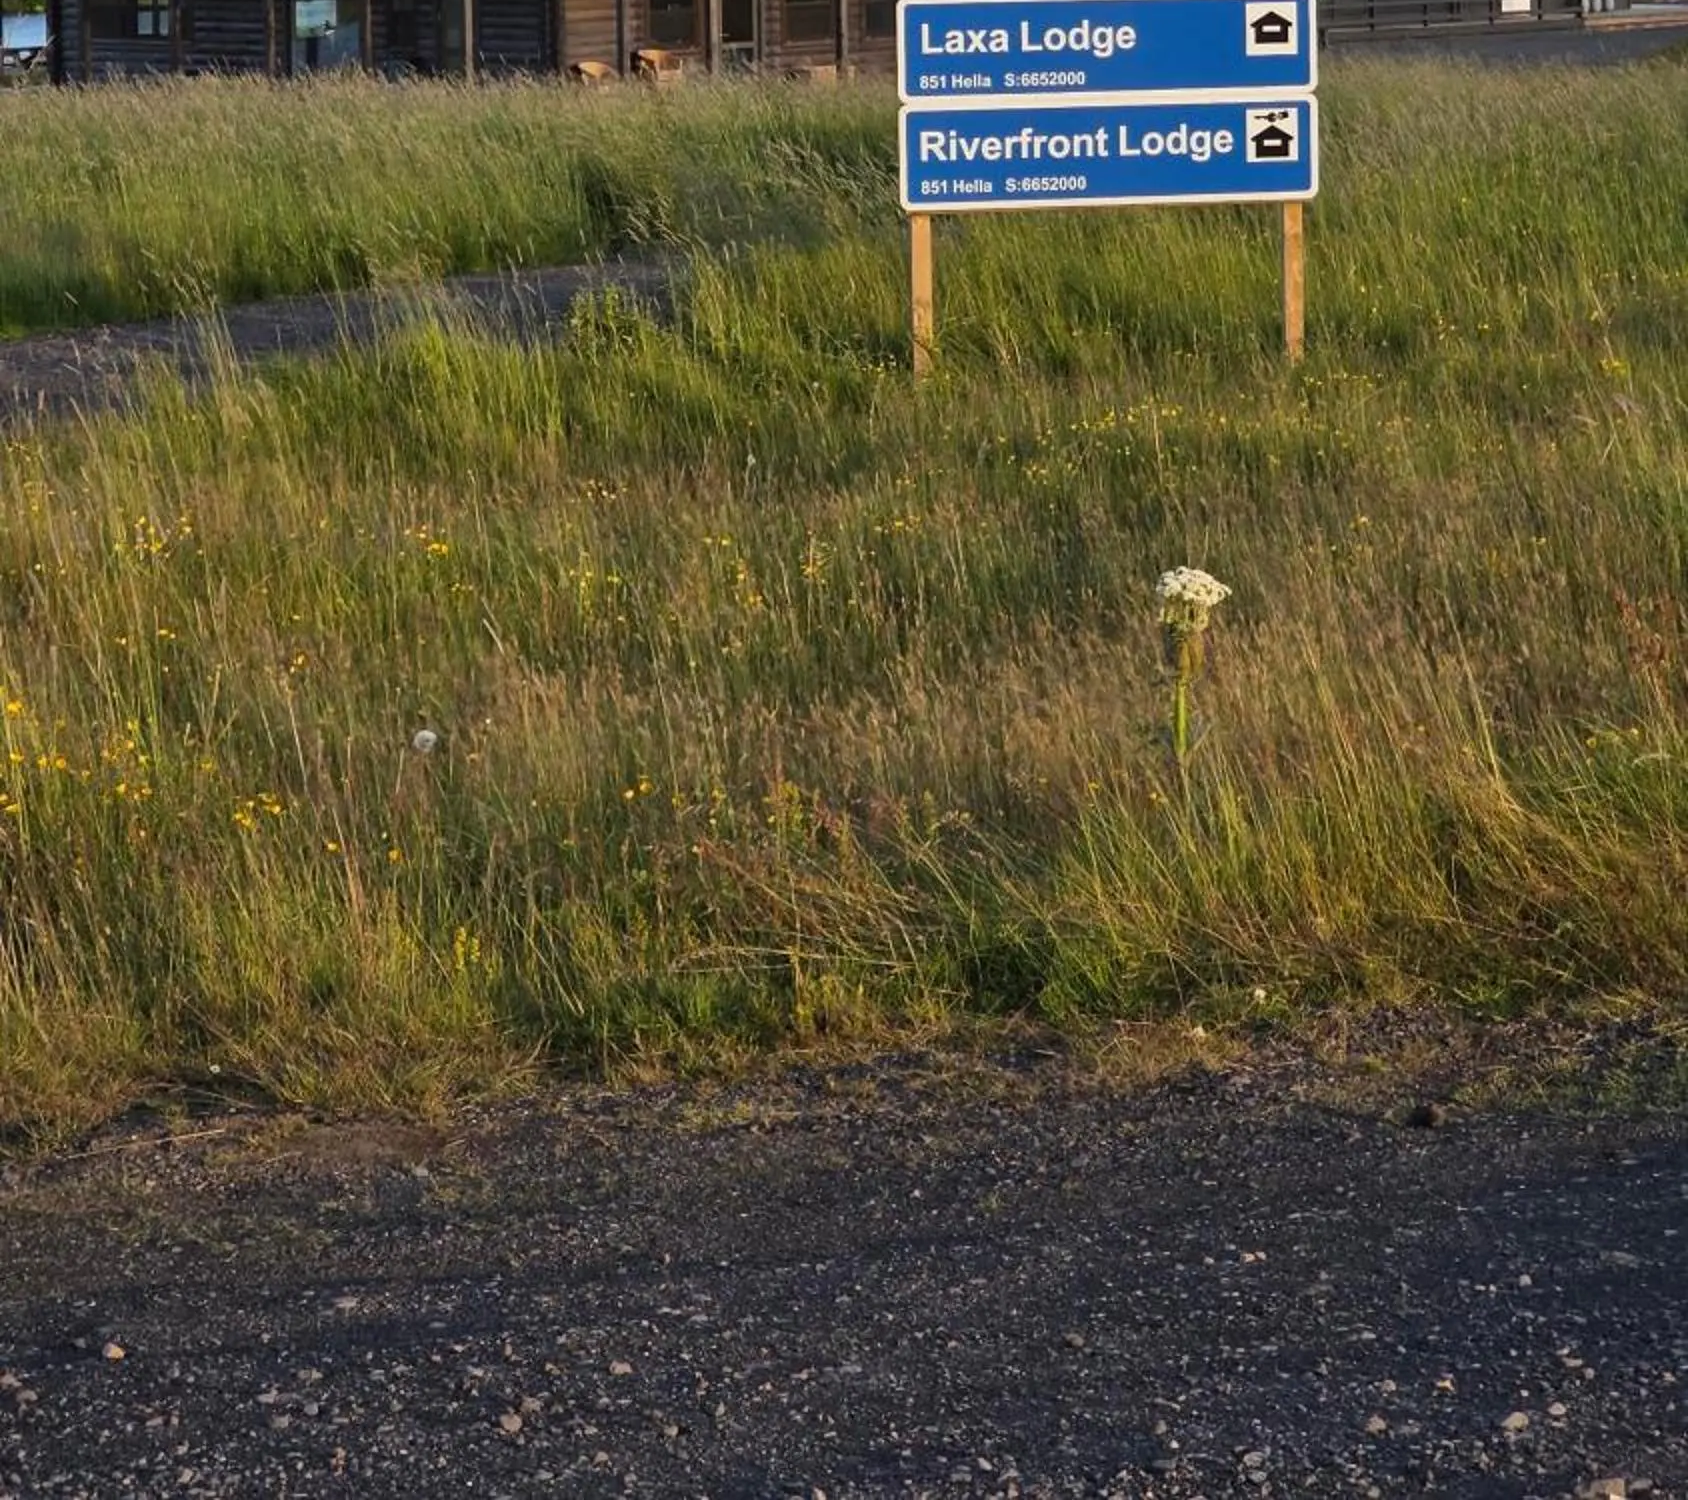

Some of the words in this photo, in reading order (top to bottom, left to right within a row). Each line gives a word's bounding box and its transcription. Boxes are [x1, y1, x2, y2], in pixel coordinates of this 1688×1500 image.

[920, 22, 1009, 55] Laxa
[1020, 19, 1136, 58] Lodge
[919, 74, 947, 90] 851
[950, 73, 992, 89] Hella
[1003, 70, 1086, 88] S:6652000
[919, 127, 1108, 163] Riverfront
[1119, 123, 1234, 162] Lodge
[920, 179, 948, 196] 851
[952, 179, 993, 194] Hella
[1005, 175, 1087, 193] S:6652000
